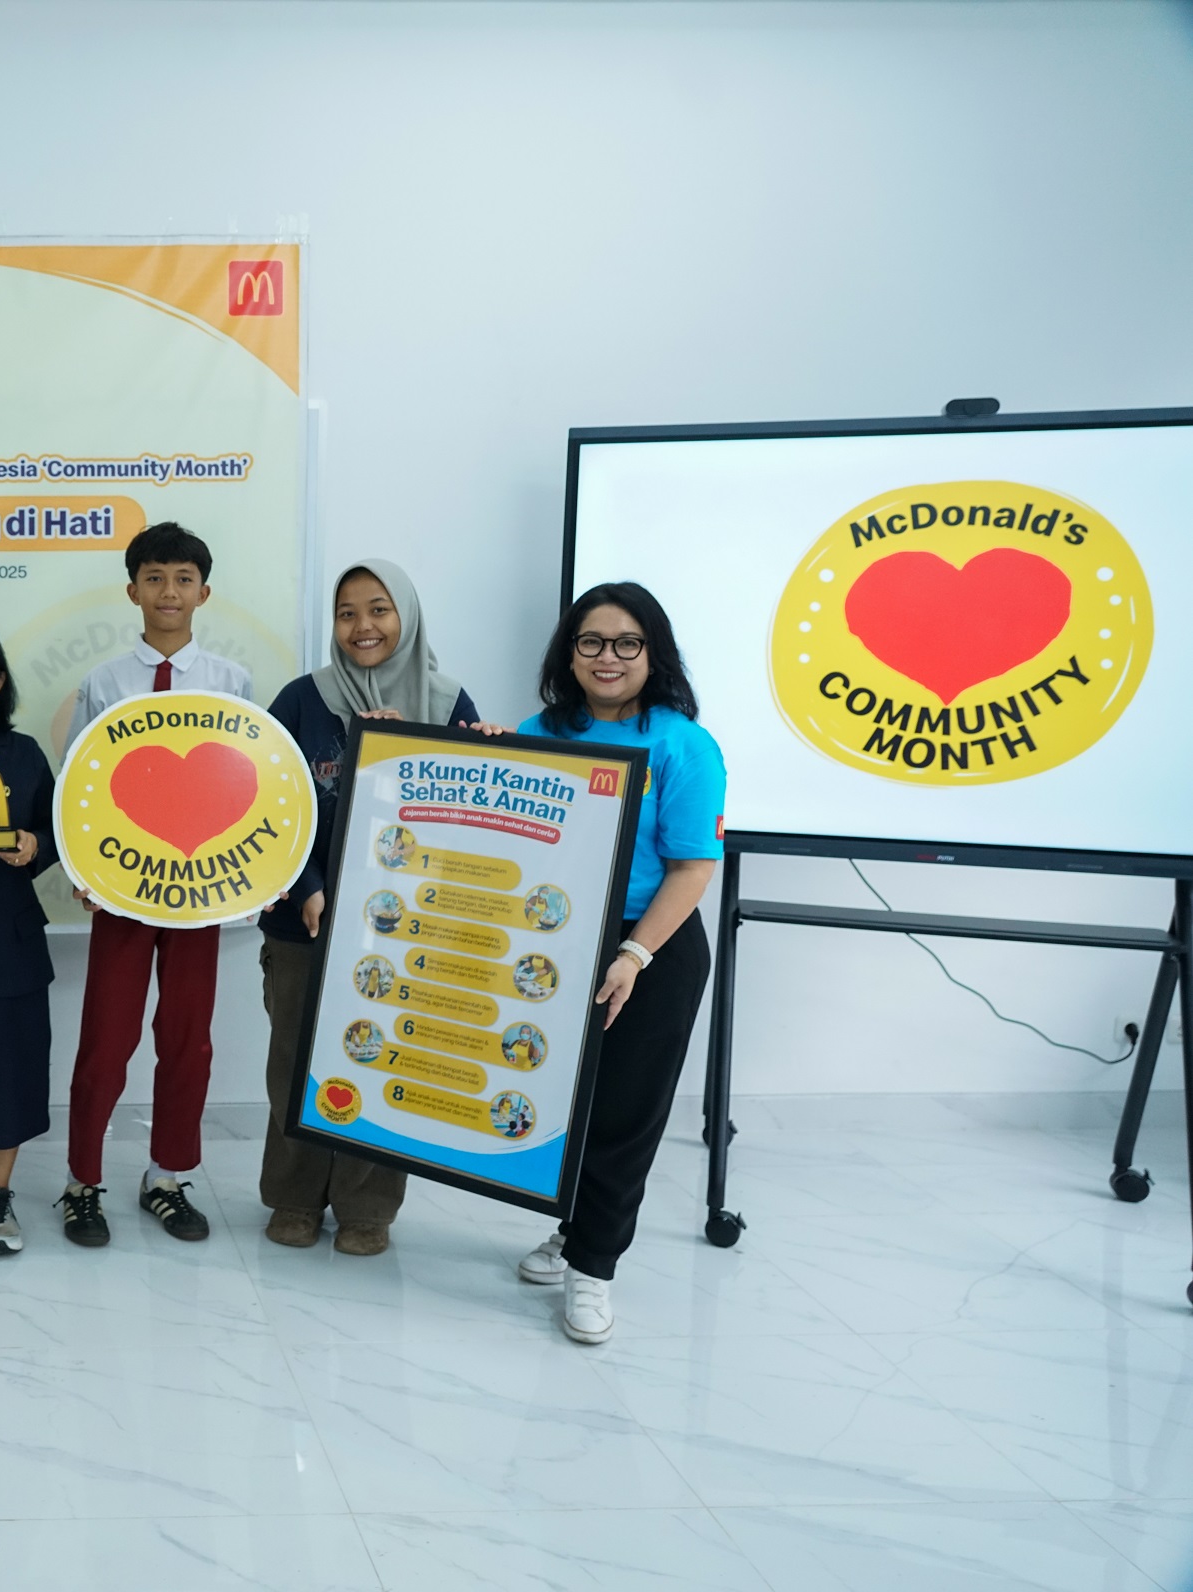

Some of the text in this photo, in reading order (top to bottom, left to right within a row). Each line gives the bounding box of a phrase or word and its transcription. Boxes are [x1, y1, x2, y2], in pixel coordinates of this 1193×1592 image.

[42, 459, 171, 481] 'Community
[175, 458, 248, 477] Month'
[6, 508, 35, 536] di
[44, 508, 112, 536] Hati
[849, 502, 1089, 548] McDonald's
[818, 655, 1091, 736] COMMUNITY
[106, 710, 261, 744] McDonald's
[862, 725, 1038, 771] MONTH
[399, 761, 575, 803] 8 Kunci Kantin
[400, 782, 566, 824] Sehat & Aman
[403, 808, 556, 839] Jajanan bersih bikin anak makin sehat dan ceria!
[98, 817, 280, 882] COMMUNITY
[422, 854, 429, 869] 1
[134, 871, 254, 909] MONTH
[424, 888, 436, 904] 2
[409, 919, 420, 935] 3
[414, 955, 425, 969] 4
[398, 985, 410, 1000] 5
[403, 1020, 415, 1035] 6
[388, 1050, 399, 1065] 7
[393, 1086, 404, 1101] 8
